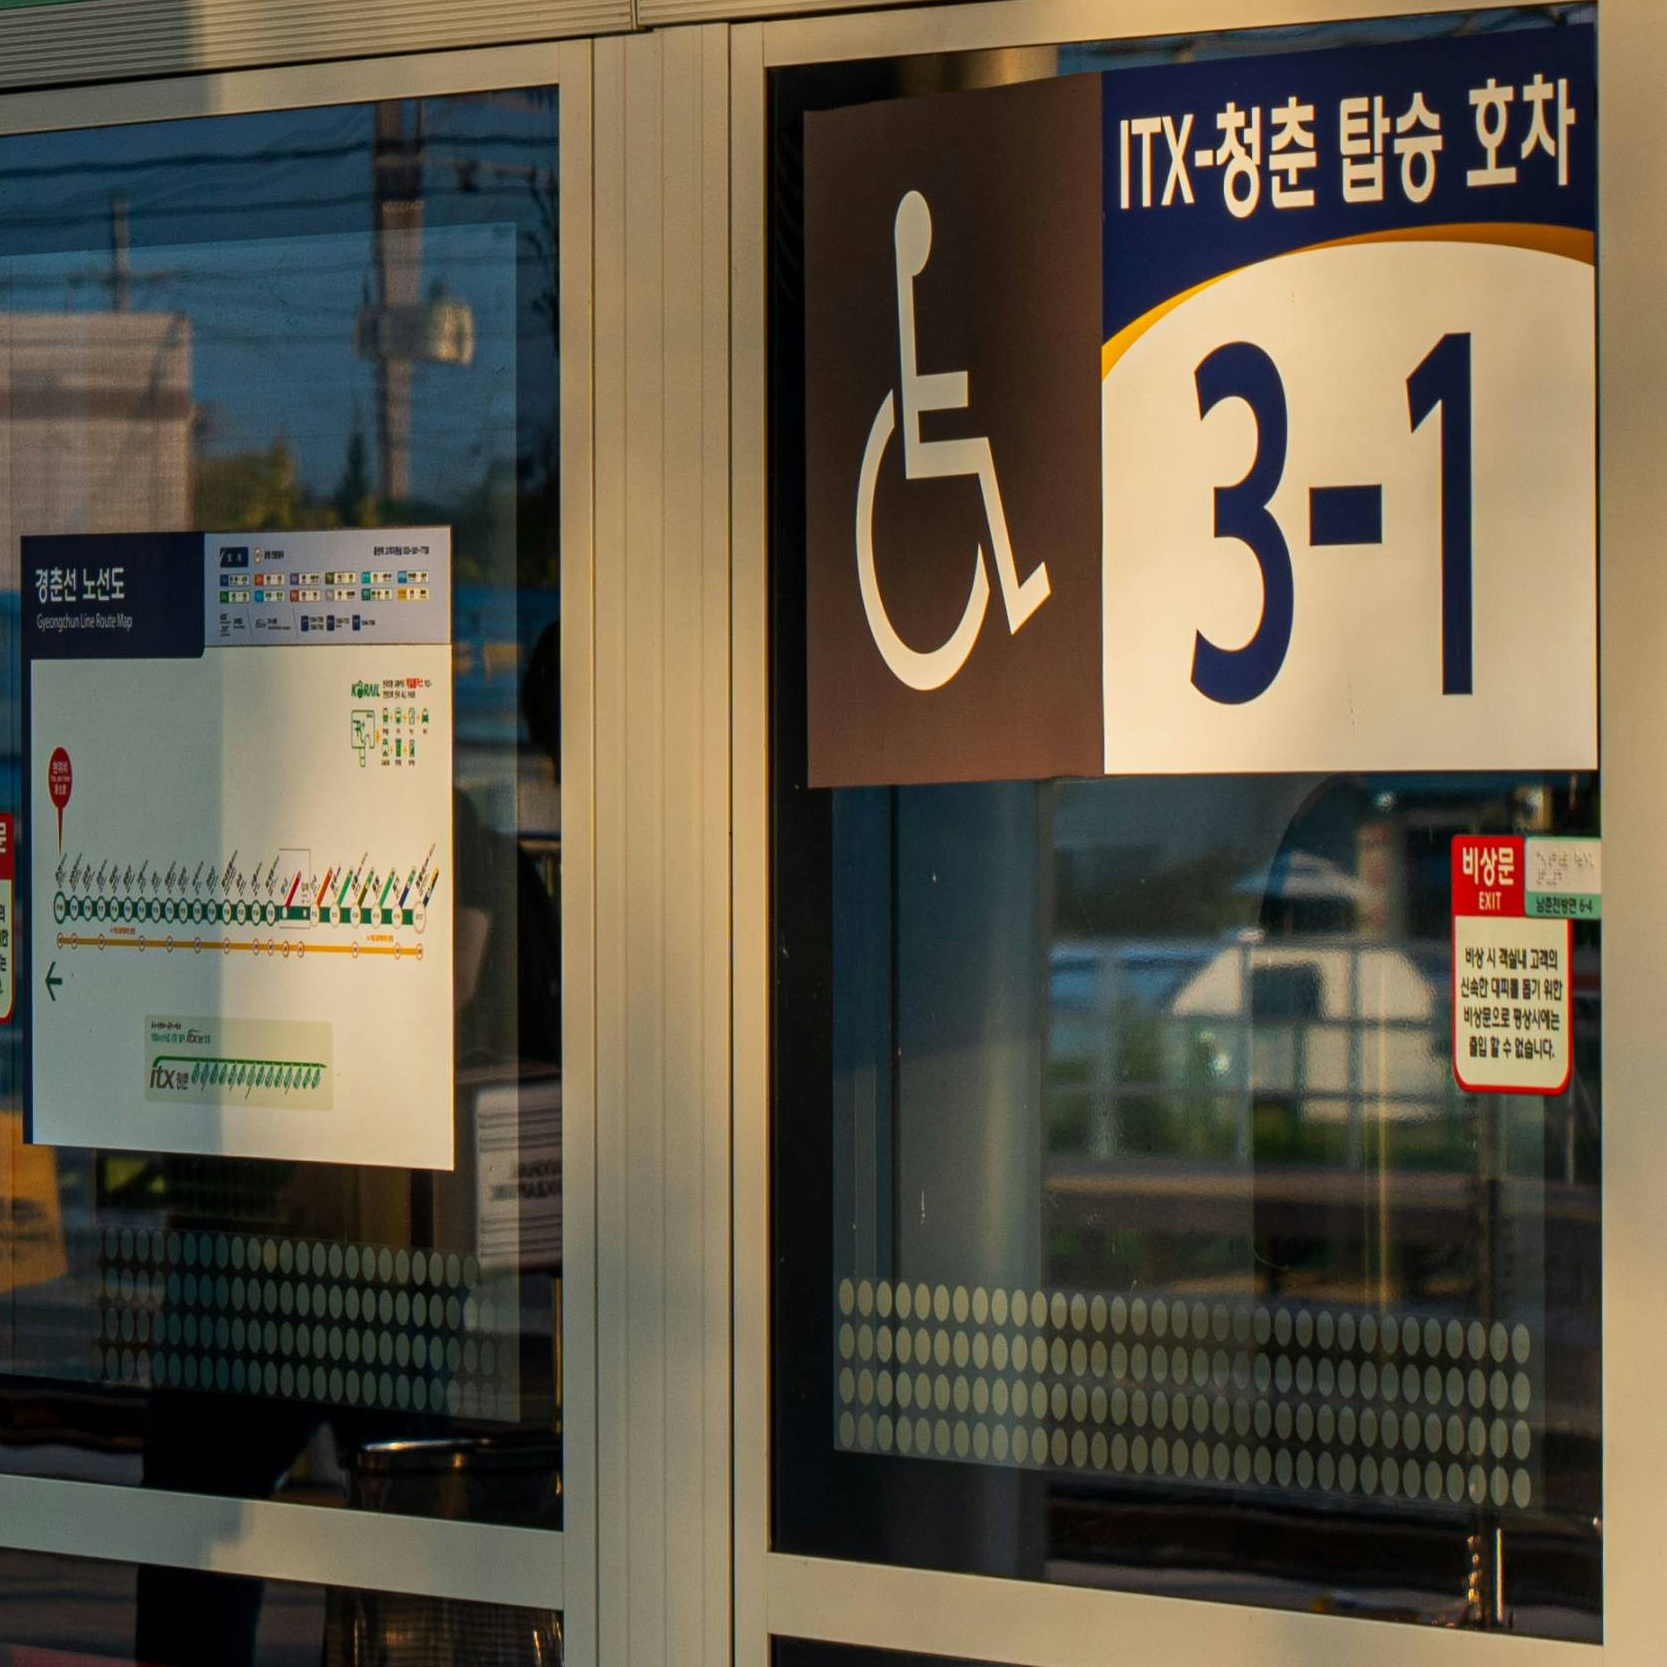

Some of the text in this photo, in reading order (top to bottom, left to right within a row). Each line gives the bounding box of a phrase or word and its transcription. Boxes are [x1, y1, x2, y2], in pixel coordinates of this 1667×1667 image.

[1119, 72, 1576, 219] ITX-청춘 탑승 호차
[1189, 331, 1475, 706] 3-1
[35, 567, 126, 604] 경춘선 노선도
[36, 612, 133, 633] Gyeongchun Line Route Map
[1462, 846, 1515, 887] 비상문
[1478, 890, 1502, 911] EXIT
[1535, 895, 1578, 916] 남춘천방면
[1465, 947, 1558, 970] 비상 시 객실내 고객의
[1461, 976, 1488, 998] 신속한
[1491, 977, 1519, 1000] 대피를
[1544, 978, 1563, 1001] 위한
[1463, 1006, 1560, 1031] 비상문으로 평상시에는
[1502, 1037, 1511, 1059] 수
[1515, 1037, 1555, 1060] 없습니다.
